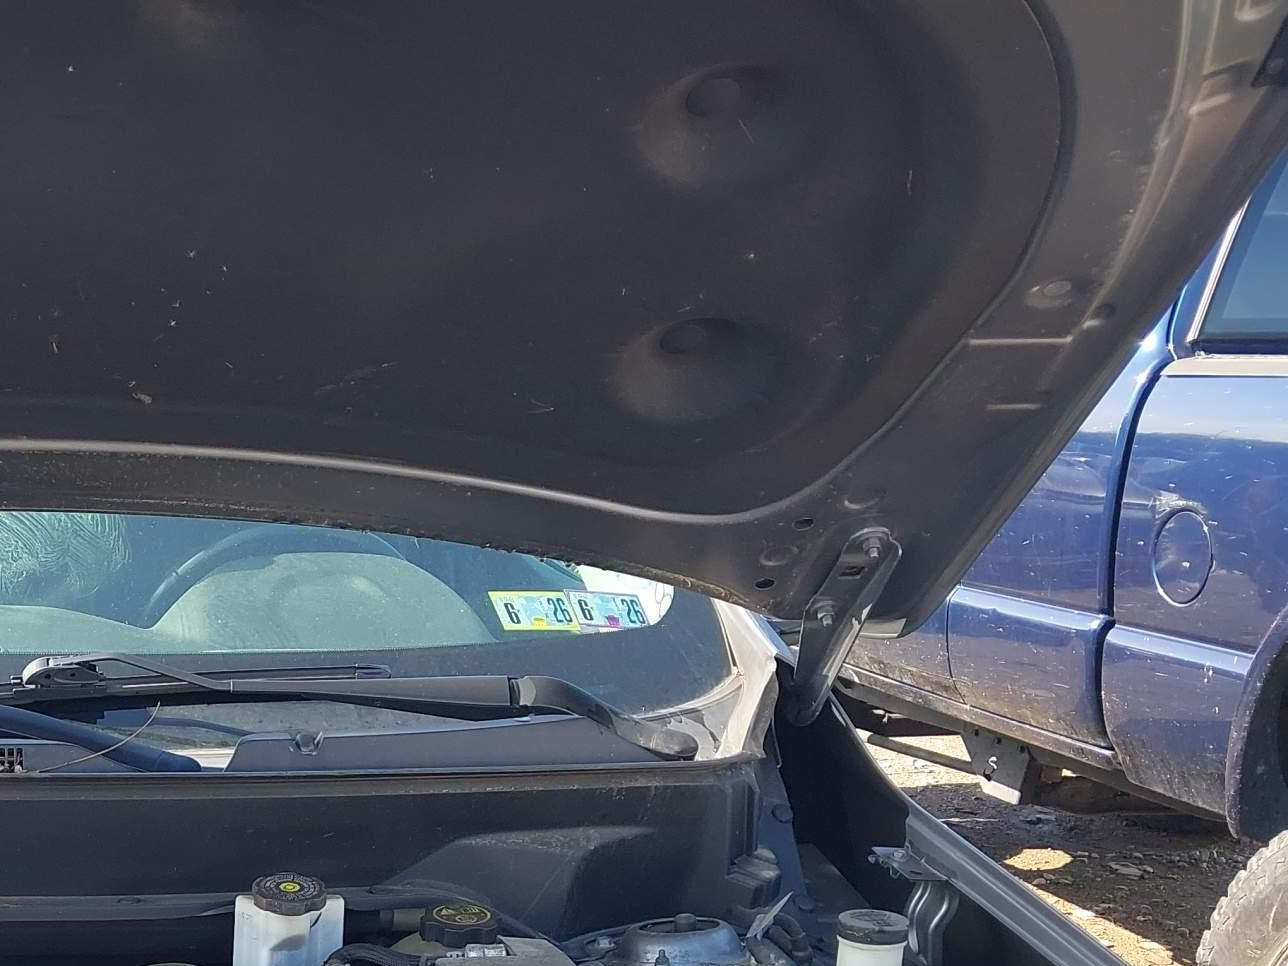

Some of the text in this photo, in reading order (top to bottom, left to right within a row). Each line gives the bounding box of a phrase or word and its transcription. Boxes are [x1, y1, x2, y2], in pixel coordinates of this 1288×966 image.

[503, 597, 573, 624] 6 26
[577, 599, 646, 624] 6 26
